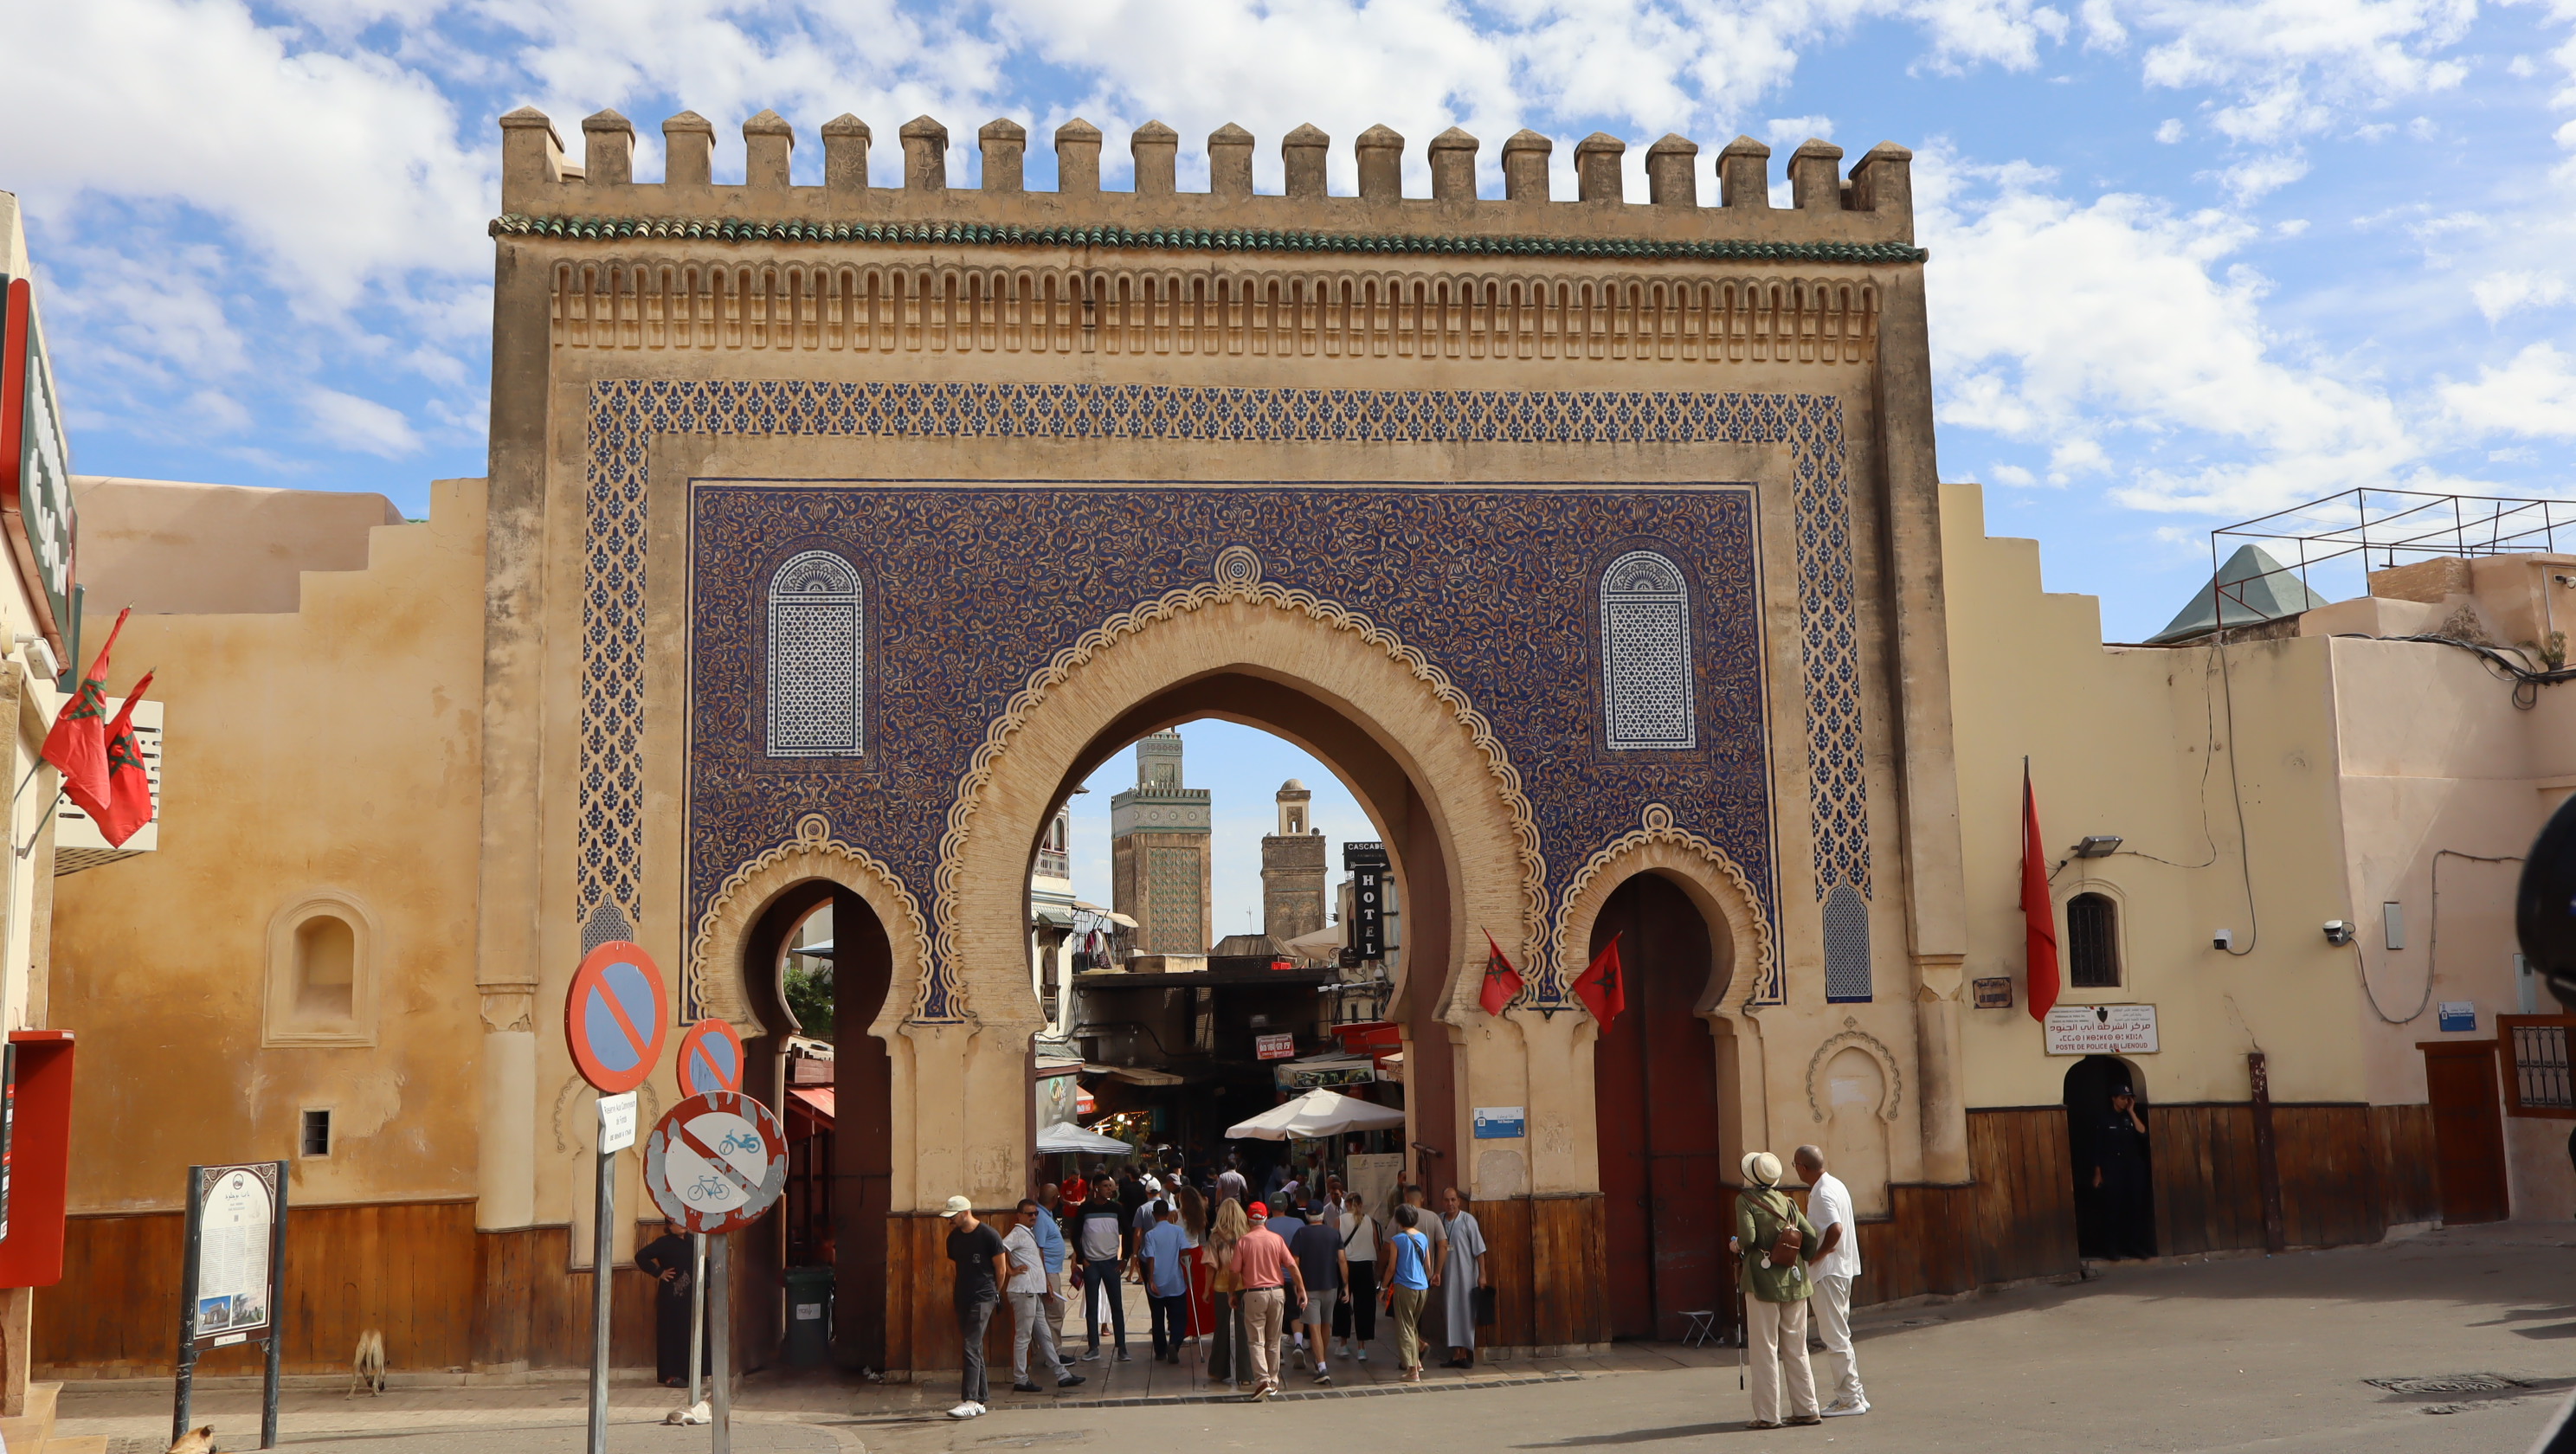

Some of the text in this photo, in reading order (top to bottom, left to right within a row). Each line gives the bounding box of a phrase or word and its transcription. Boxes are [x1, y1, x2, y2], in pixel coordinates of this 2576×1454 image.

[1362, 874, 1375, 955] HOTEL
[2050, 1023, 2077, 1033] الجنود
[2097, 1022, 2128, 1033] الشرطة
[2130, 1022, 2151, 1032] مركز
